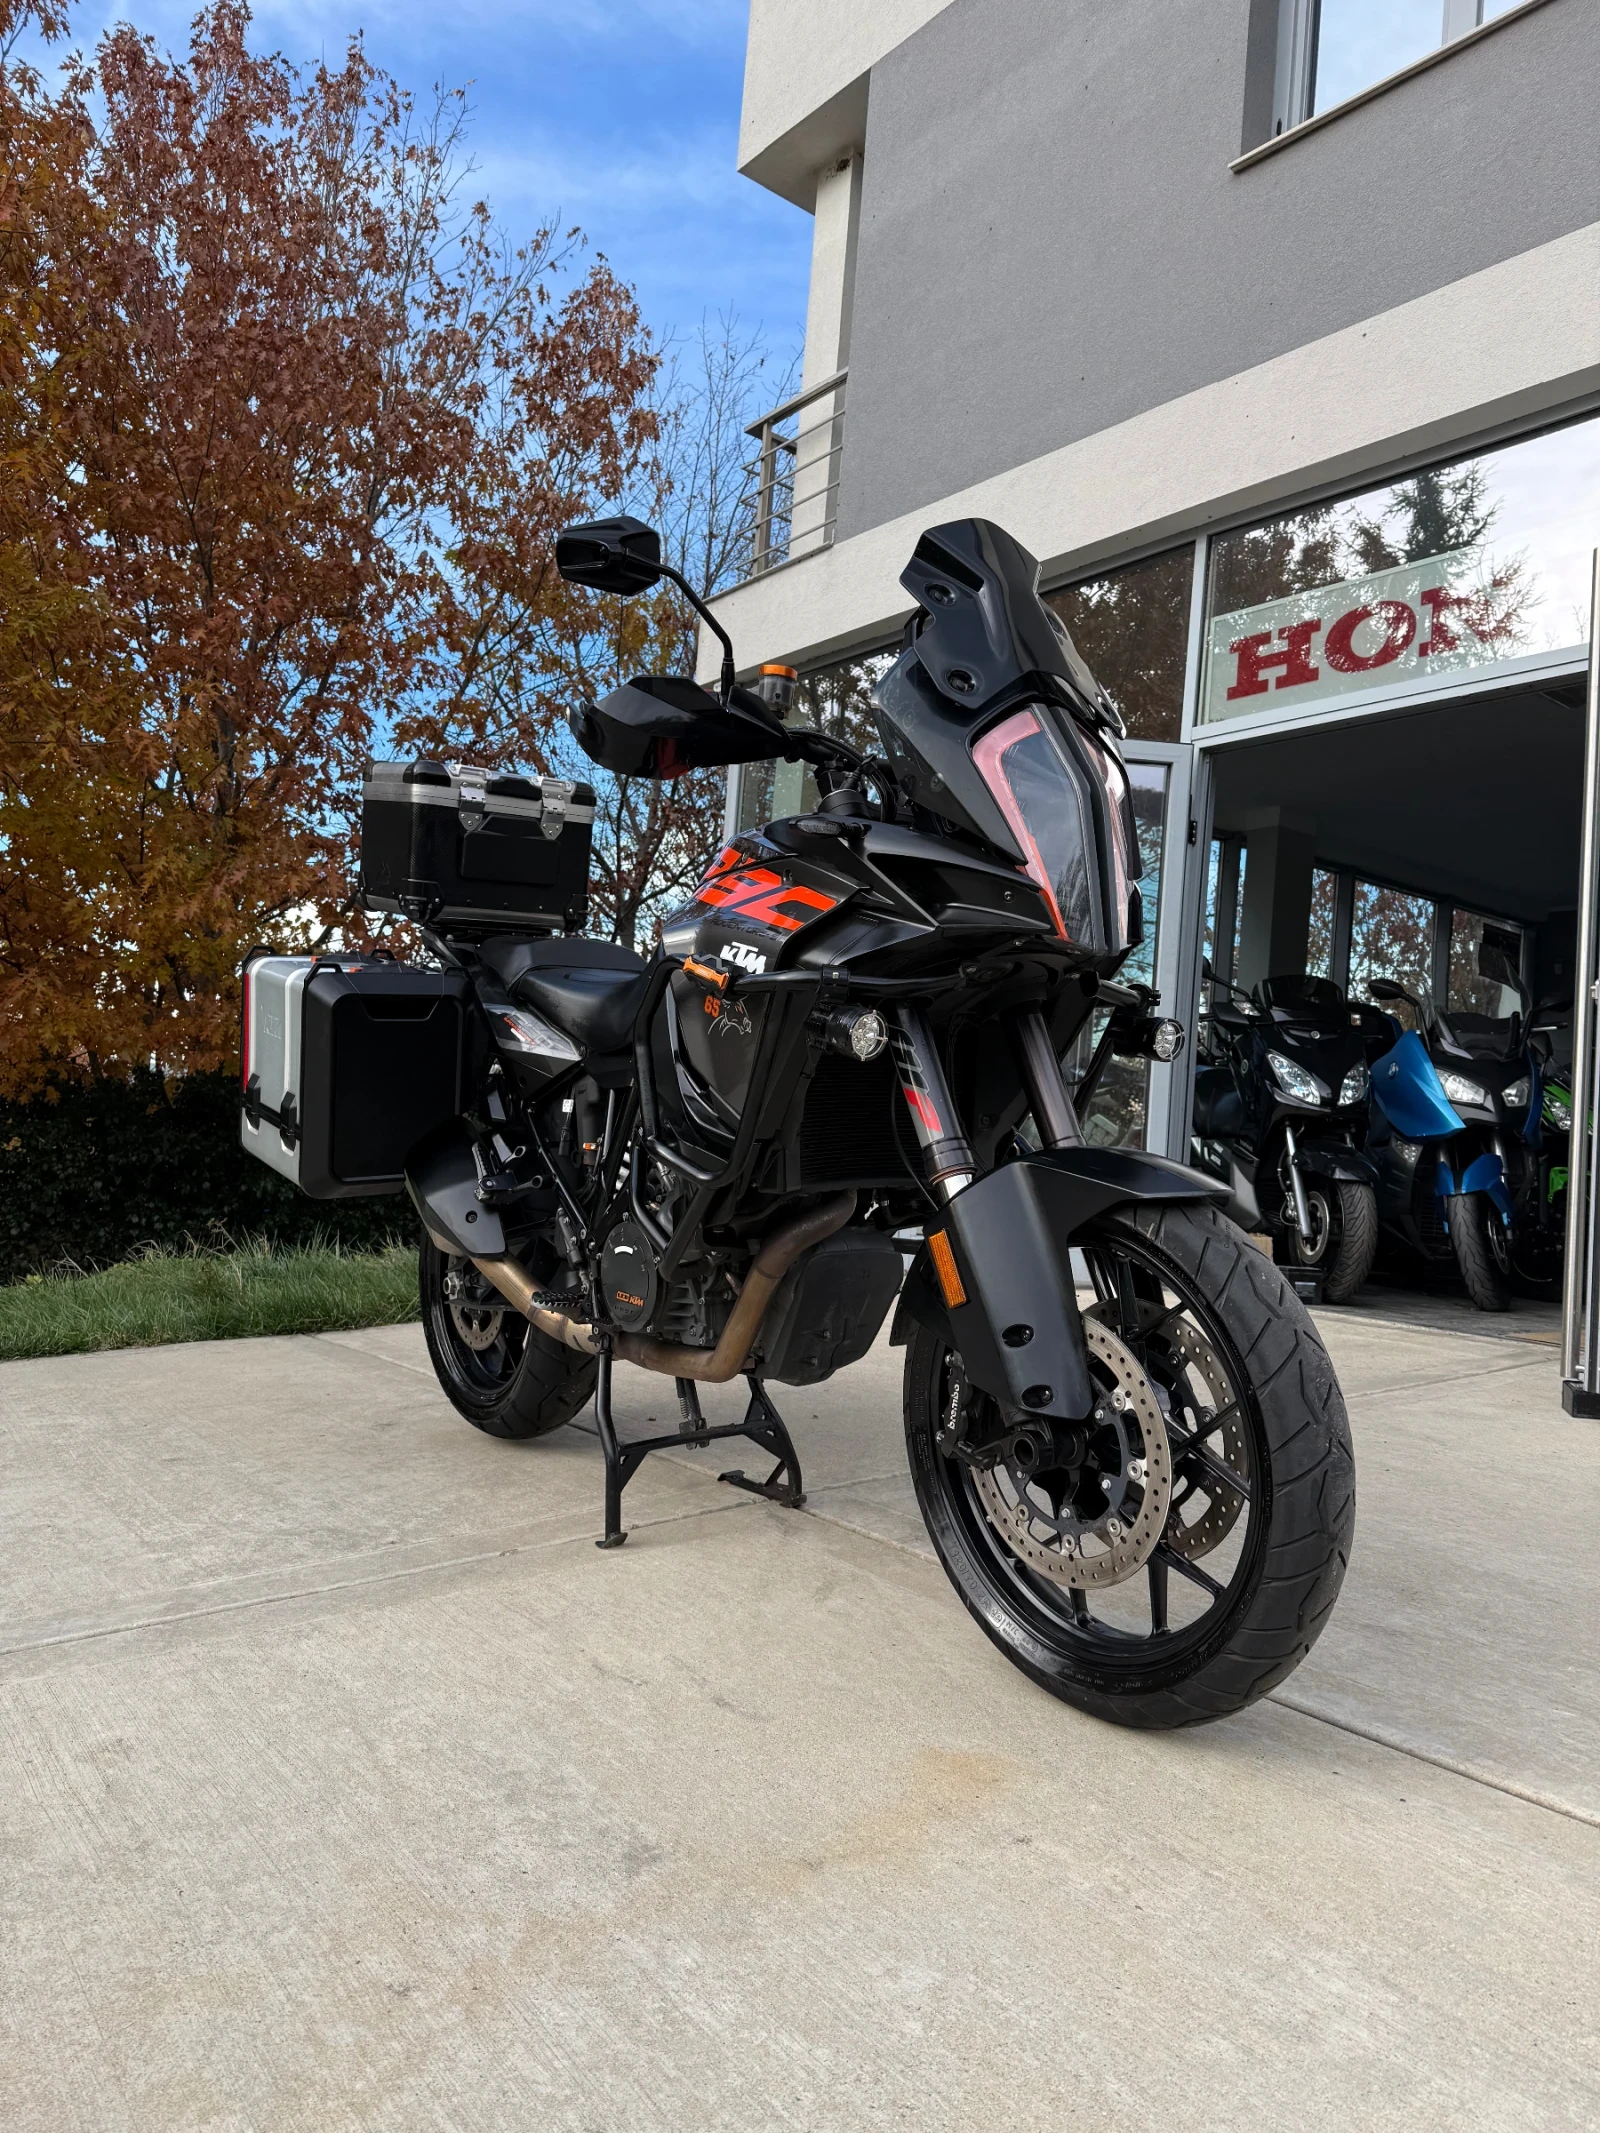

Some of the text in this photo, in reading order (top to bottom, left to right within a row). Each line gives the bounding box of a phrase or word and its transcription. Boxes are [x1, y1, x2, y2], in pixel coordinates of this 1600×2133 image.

[720, 941, 767, 975] KTM
[704, 995, 720, 1018] 65
[947, 1383, 960, 1430] brembo
